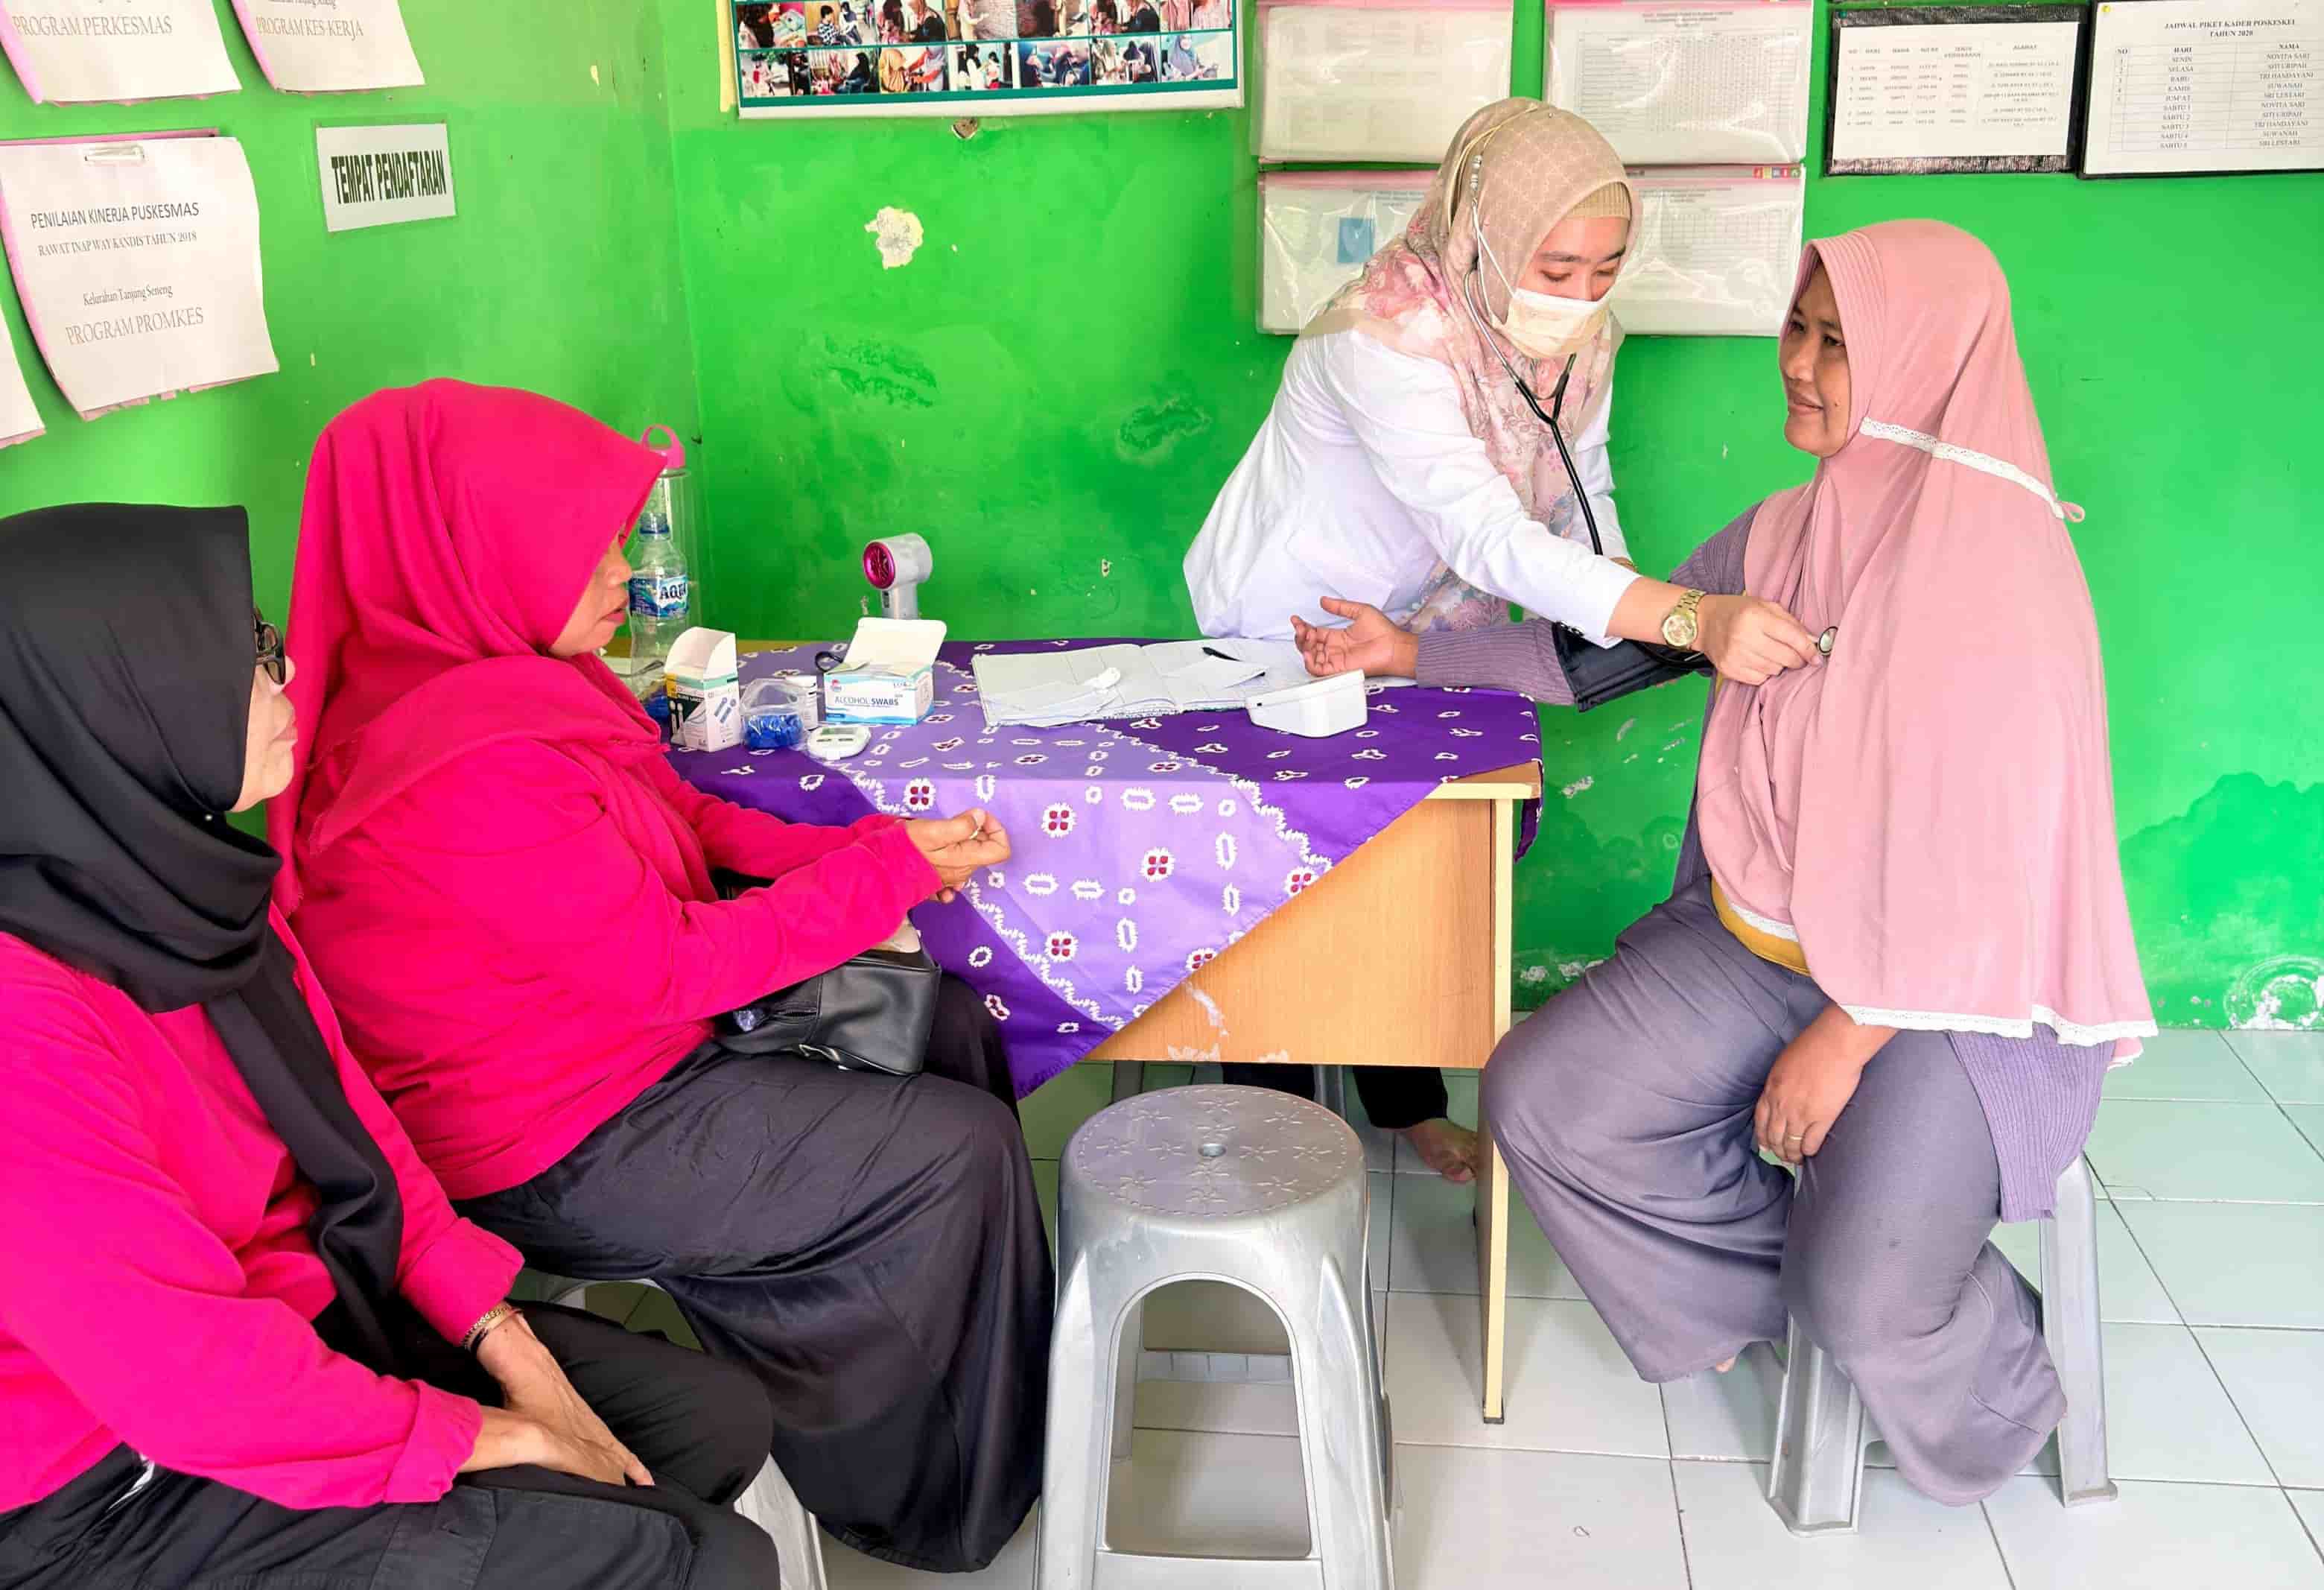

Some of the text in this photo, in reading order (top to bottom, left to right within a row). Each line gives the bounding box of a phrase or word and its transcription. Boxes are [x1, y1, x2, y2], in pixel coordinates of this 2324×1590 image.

[12, 15, 173, 36] PROGRAM PERKESMAS
[256, 16, 364, 41] PROGRAM KES-KERJA
[2165, 22, 2197, 30] JADWAL
[331, 149, 447, 205] TEMPAT PENDAFTARAN
[31, 202, 200, 229] PENILAIAN KINERJA PUSKESMAS
[38, 242, 71, 256] RAWAT
[71, 240, 92, 253] INAP
[91, 238, 112, 252] WAY
[145, 233, 177, 246] TAHUN
[176, 231, 197, 243] 2018
[83, 287, 118, 305] Kelurahan
[118, 288, 147, 302] Tanjung
[66, 306, 204, 345] PROGRAM PROMKES
[660, 583, 687, 600] AQU
[834, 696, 899, 706] ALCOHOL SWABS
